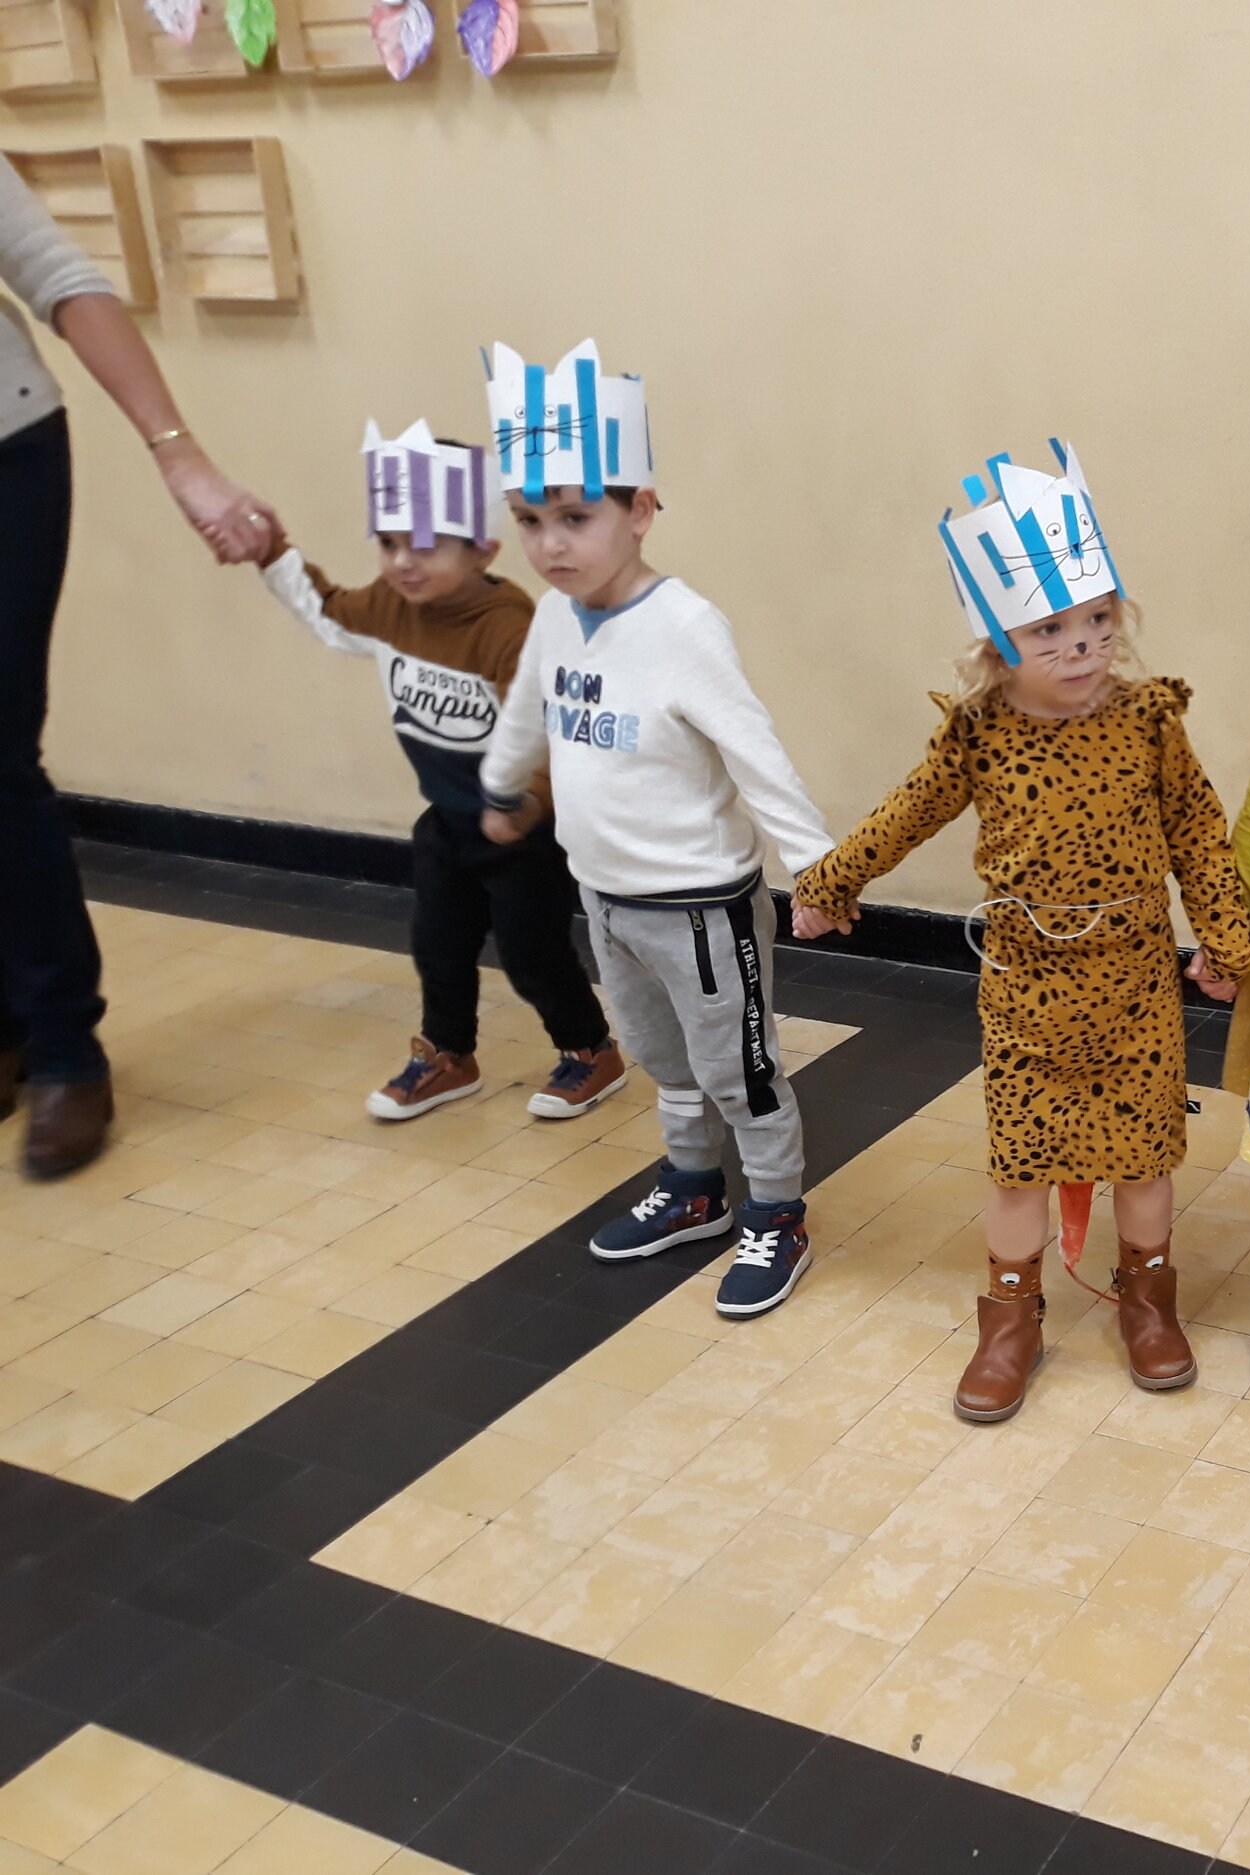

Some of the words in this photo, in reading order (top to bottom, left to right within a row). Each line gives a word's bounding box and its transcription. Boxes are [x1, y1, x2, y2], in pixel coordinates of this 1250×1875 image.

[390, 656, 497, 726] Campus
[543, 698, 641, 752] OYAGE
[740, 938, 759, 993] ATHLET
